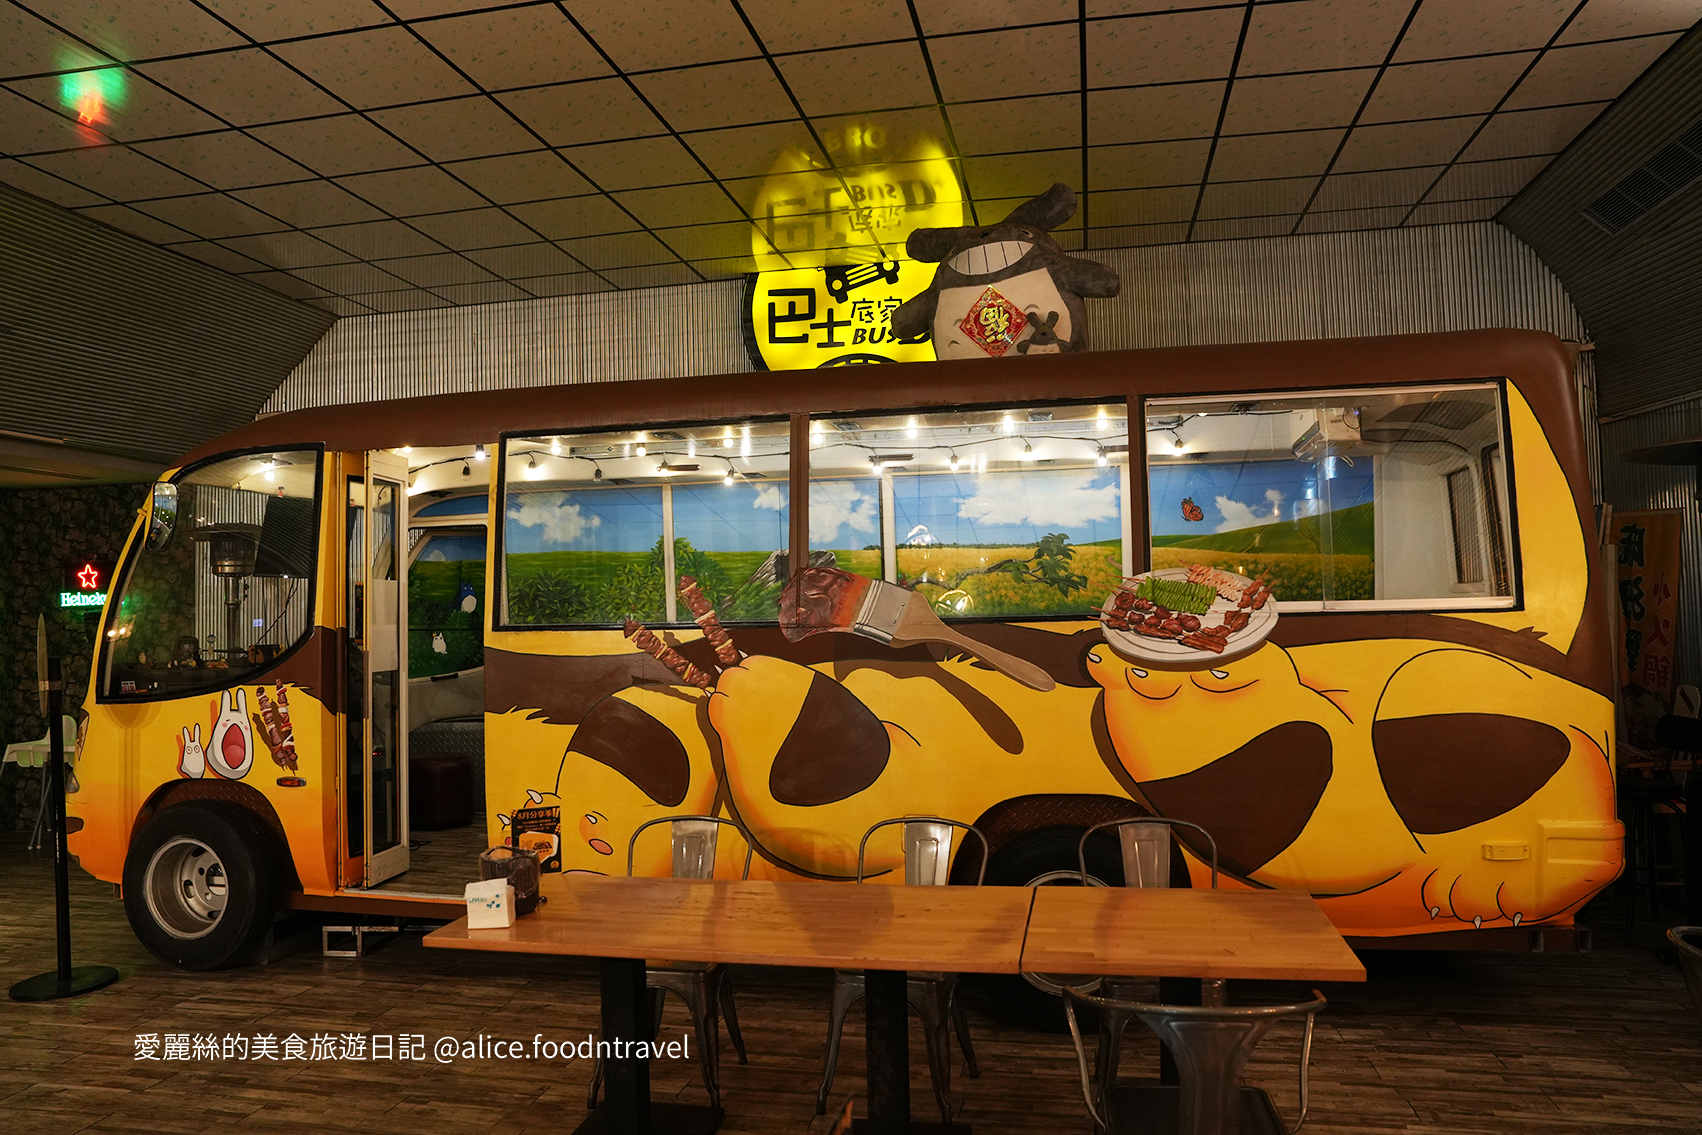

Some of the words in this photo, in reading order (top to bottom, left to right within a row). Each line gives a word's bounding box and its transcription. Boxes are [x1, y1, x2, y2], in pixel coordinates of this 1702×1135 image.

[767, 288, 851, 349] 巴士
[851, 327, 897, 345] BUS
[60, 591, 107, 607] Heinek
